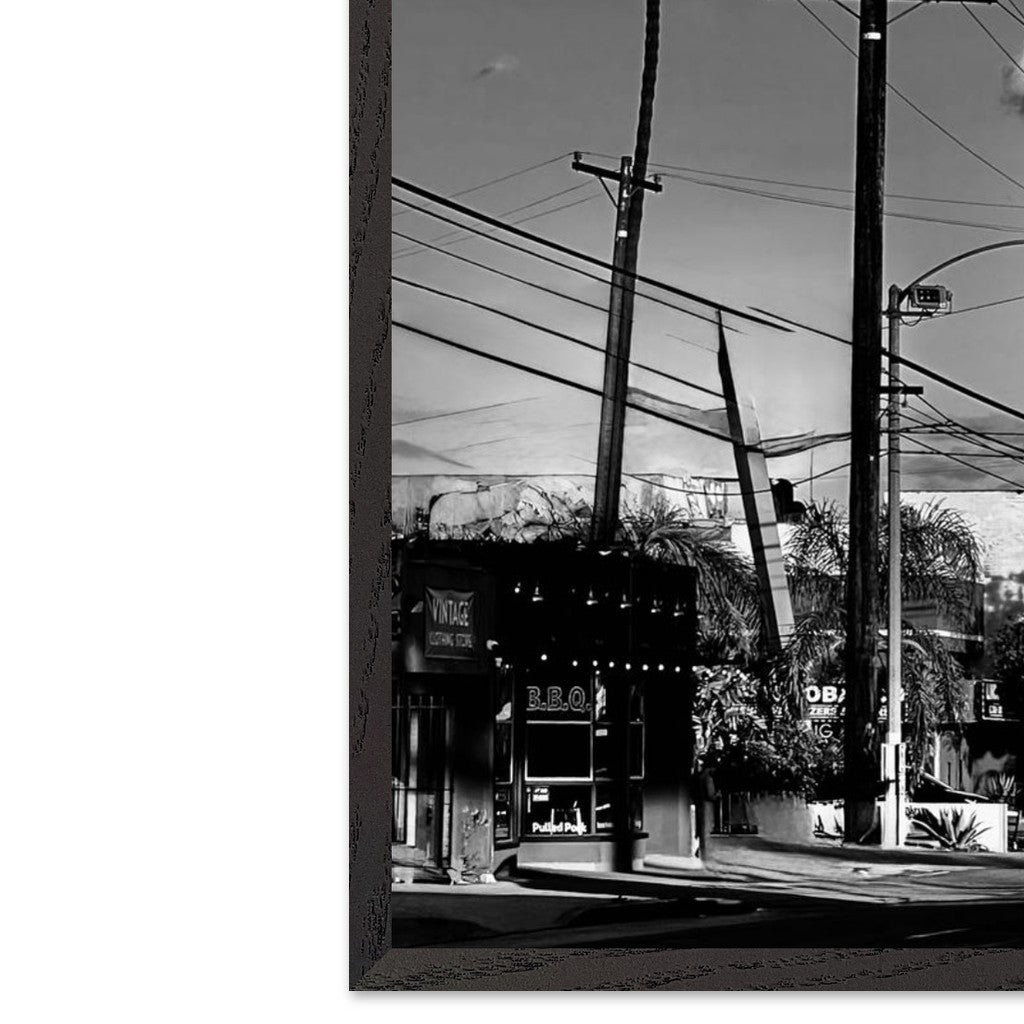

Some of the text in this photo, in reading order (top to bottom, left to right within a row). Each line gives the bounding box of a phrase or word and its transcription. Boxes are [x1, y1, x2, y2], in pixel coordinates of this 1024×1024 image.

[432, 598, 469, 627] VINTAGE
[526, 685, 592, 713] B.B.Q.
[564, 822, 587, 833] Pok
